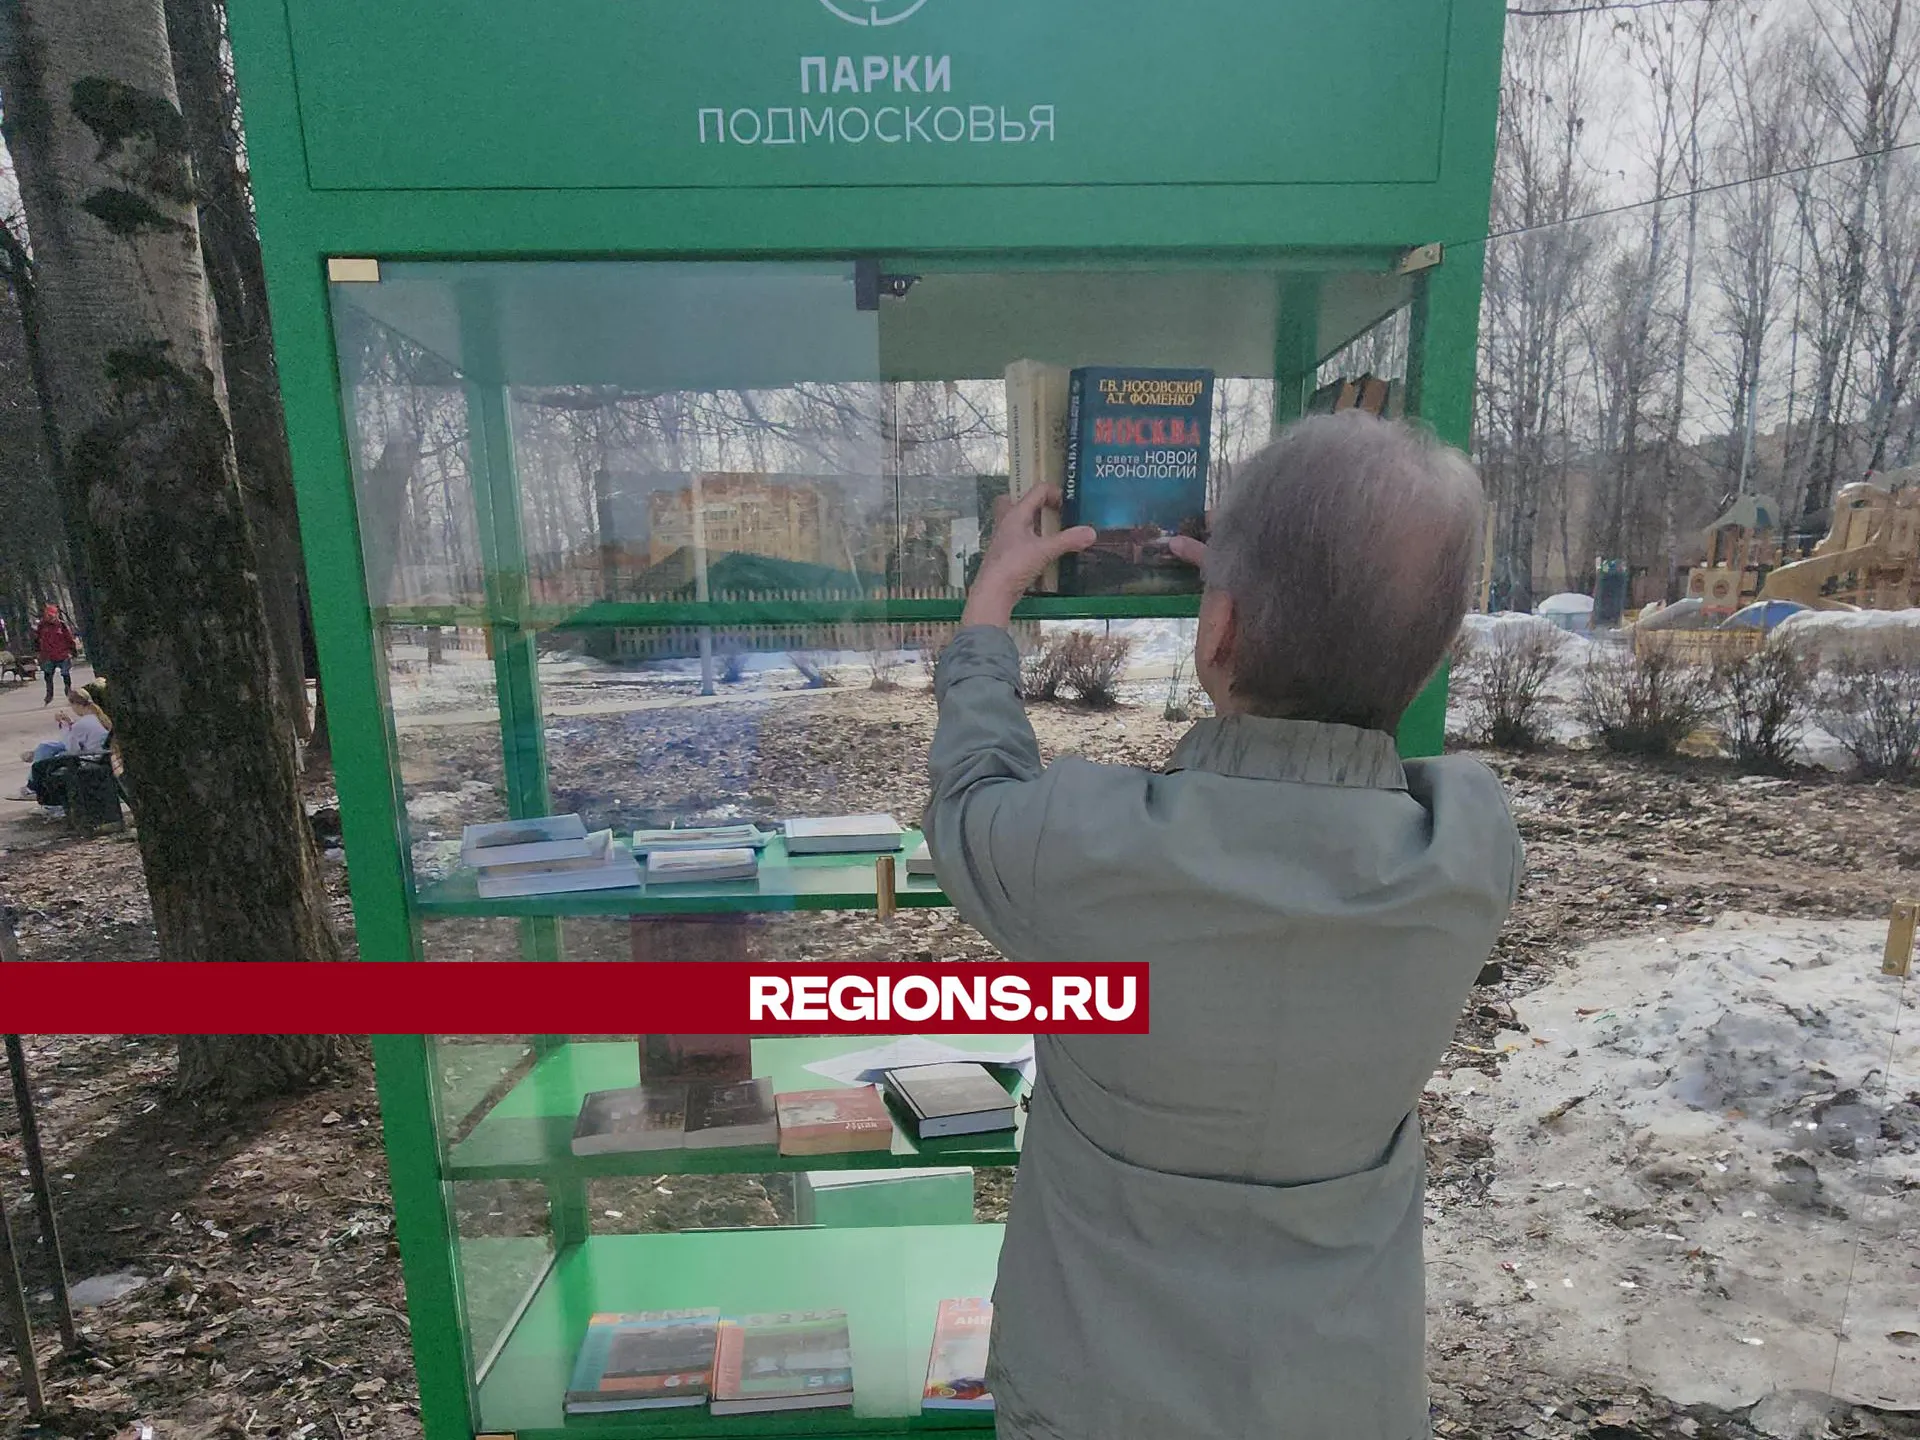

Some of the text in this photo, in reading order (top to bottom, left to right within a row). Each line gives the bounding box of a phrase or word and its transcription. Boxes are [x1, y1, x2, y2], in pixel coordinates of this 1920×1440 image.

[800, 55, 951, 94] ПАРКИ
[698, 104, 1055, 145] ПОДМОСКОВЬЯ
[1122, 379, 1203, 395] НОСОВСКИЙ
[1129, 391, 1196, 406] ФОМЕНКО
[1094, 418, 1201, 444] МОСКВА
[1144, 448, 1198, 465] НОВОЙ
[1065, 442, 1078, 500] МОСКВА
[1095, 464, 1197, 479] ХРОНОЛОГИИ
[807, 1375, 824, 1388] 5
